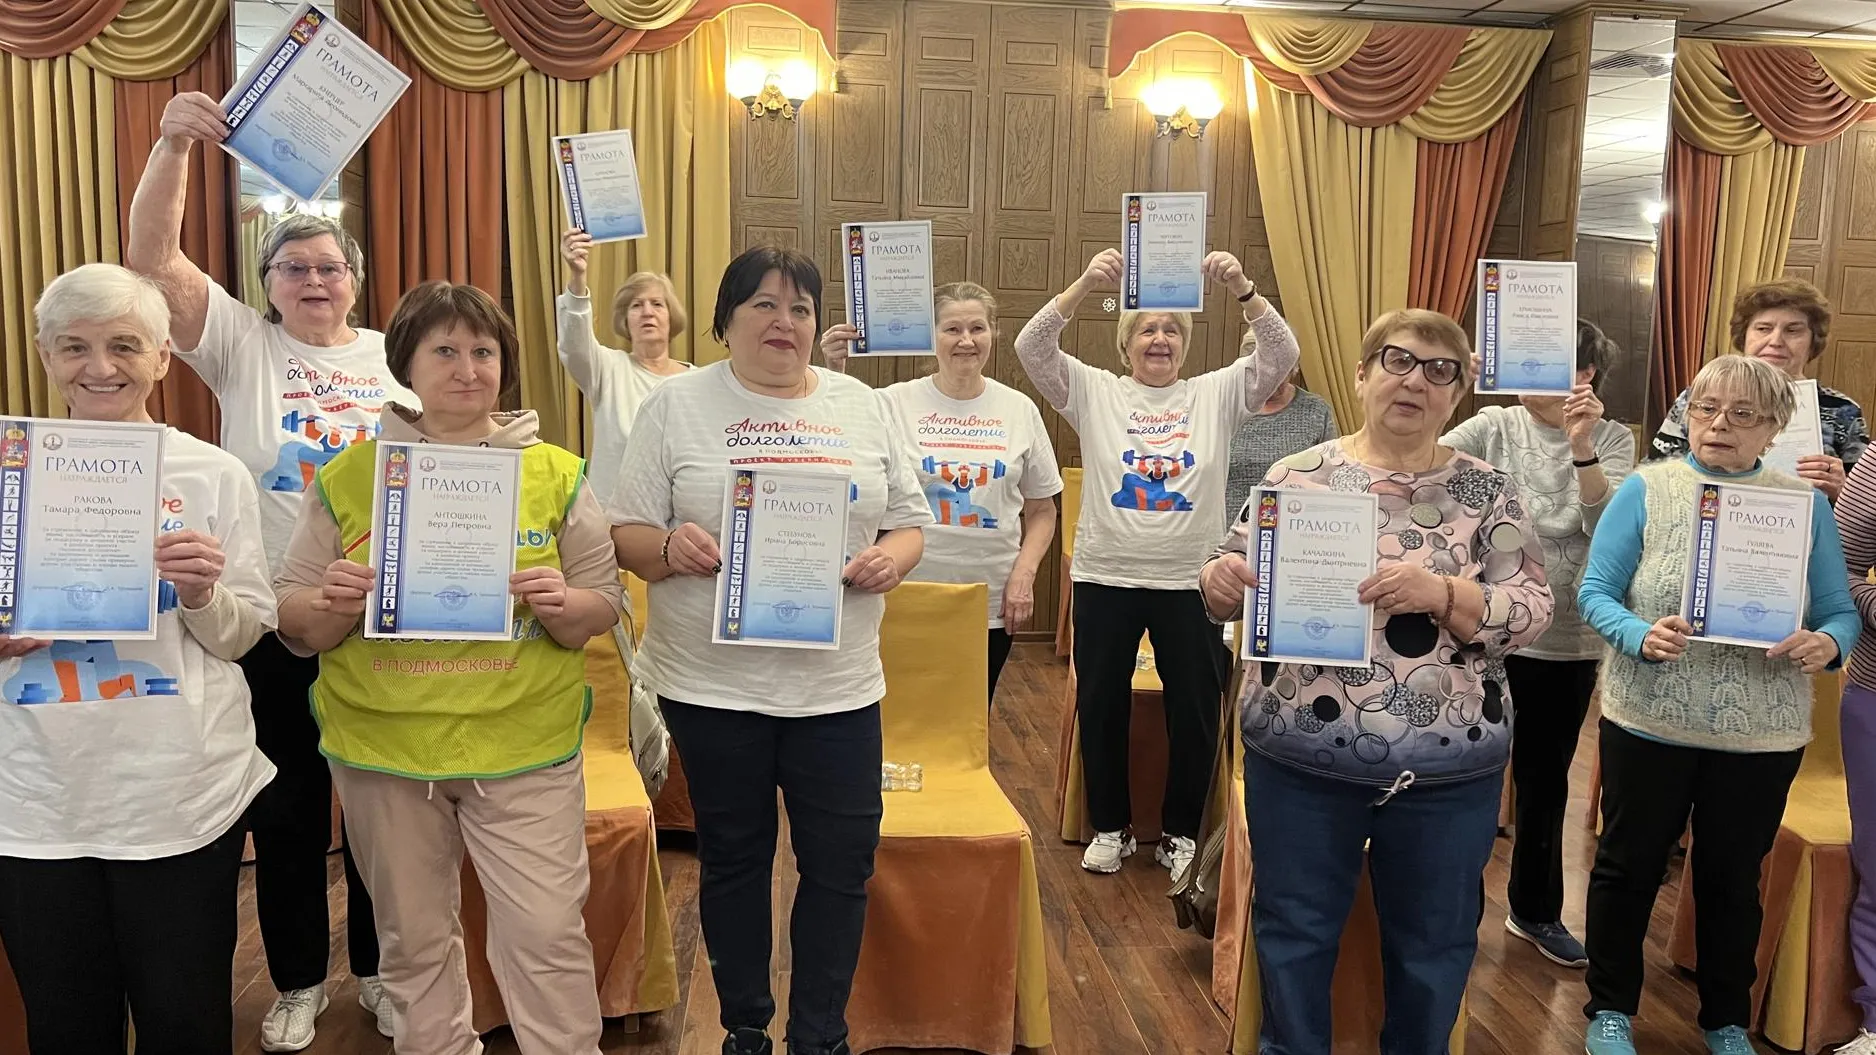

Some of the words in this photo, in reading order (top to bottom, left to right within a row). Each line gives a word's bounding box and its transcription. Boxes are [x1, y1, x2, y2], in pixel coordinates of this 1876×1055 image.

[316, 48, 378, 102] ГРАМОТА
[580, 150, 626, 161] ГРАМОТА
[1148, 213, 1195, 222] ГРАМОТА
[871, 245, 921, 255] ГРАМОТА
[1508, 284, 1563, 294] ГРАМОТА
[724, 418, 844, 435] Активное
[918, 413, 1003, 428] Активное
[918, 424, 1006, 438] долголетие
[727, 432, 850, 448] долголетие
[45, 456, 142, 474] ГРАМОТА
[421, 477, 502, 494] ГРАМОТА
[74, 495, 112, 504] РАКОВА
[764, 499, 833, 515] ГРАМОТА
[44, 505, 80, 515] Тамара
[84, 506, 142, 516] Федоровна
[434, 511, 487, 520] АНТОШКИНА
[451, 522, 492, 530] Петровна
[1289, 519, 1362, 534] ГРАМОТА
[1729, 511, 1795, 528] ГРАМОТА
[373, 660, 382, 671] В
[388, 658, 518, 675] ПОДМОСКОВЬЕ
